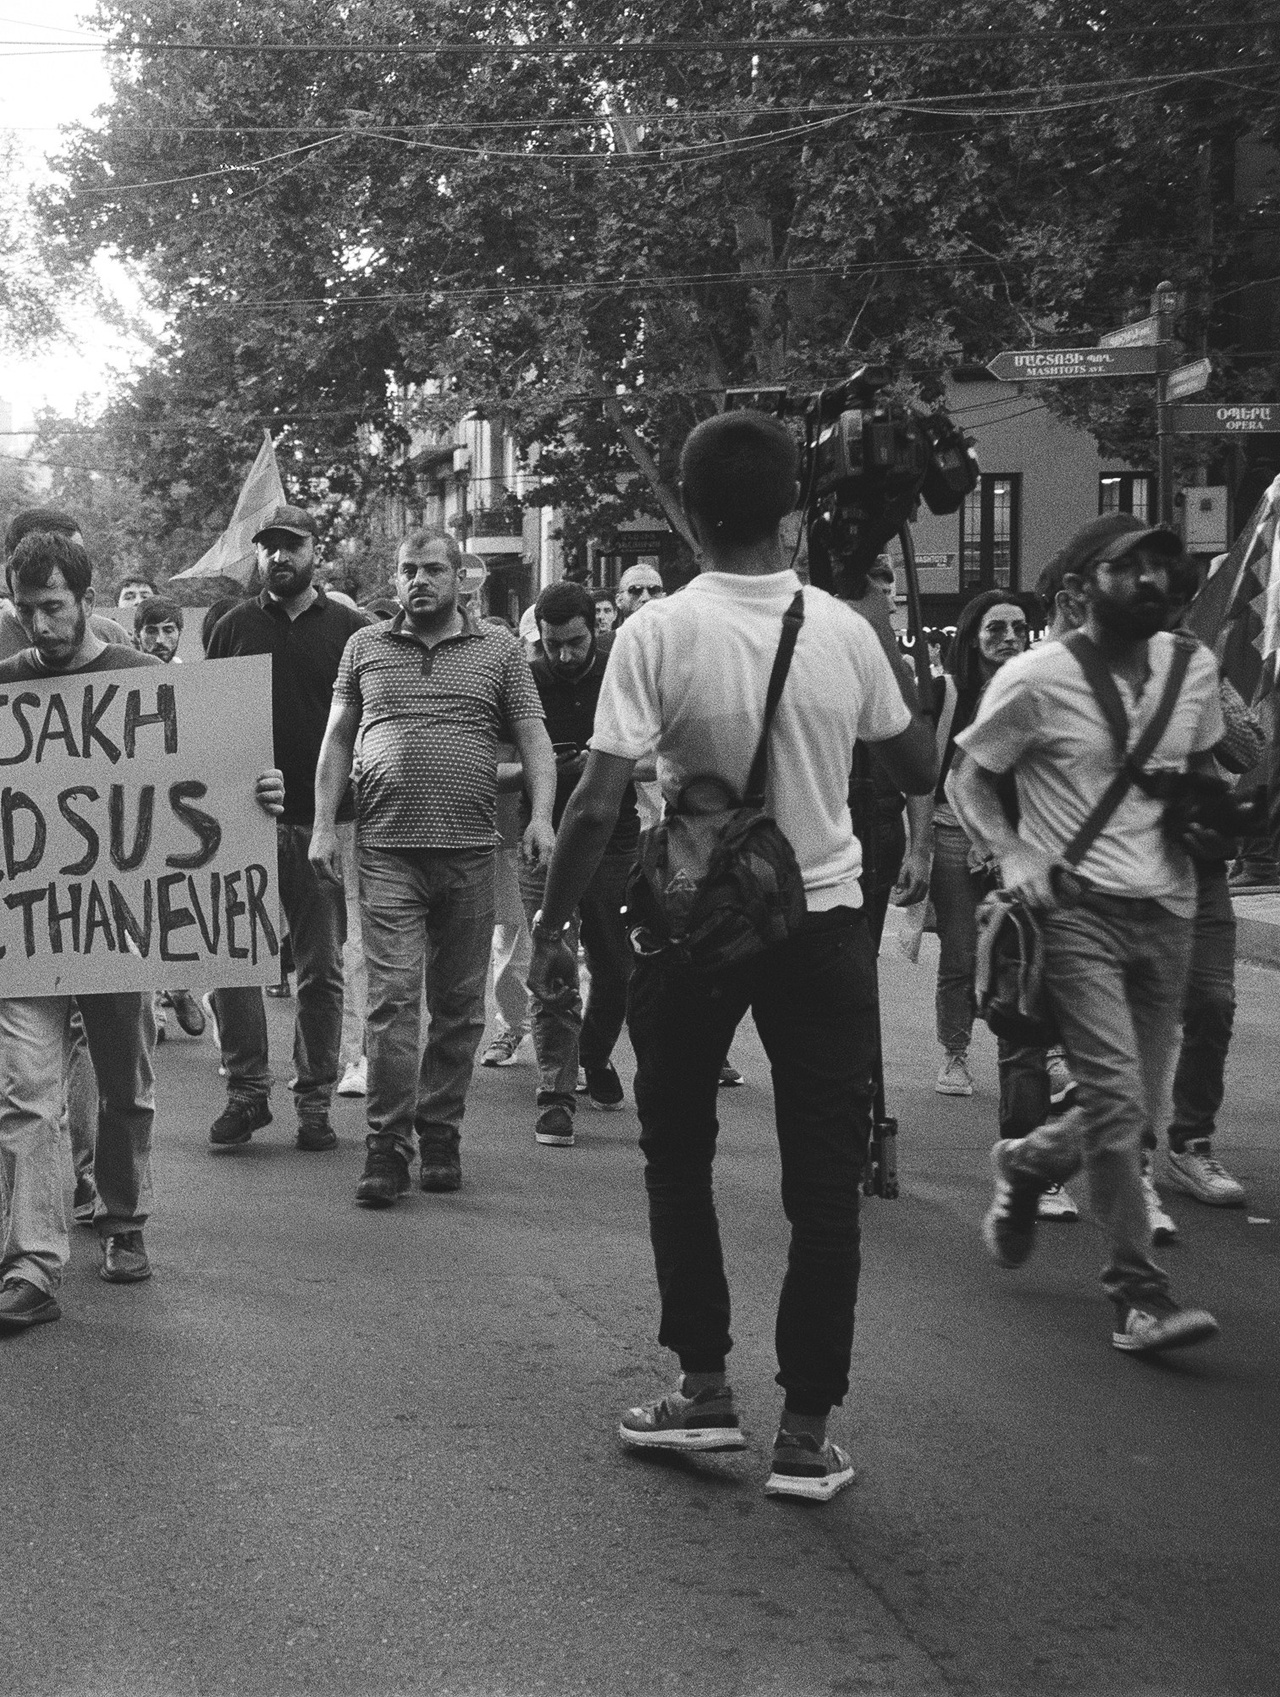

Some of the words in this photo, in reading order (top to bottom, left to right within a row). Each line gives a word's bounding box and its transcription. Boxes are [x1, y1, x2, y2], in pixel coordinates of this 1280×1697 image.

[1014, 352, 1084, 367] ՄԱՇՏՈՑԻ
[1025, 364, 1087, 376] MASHTOTS
[1216, 406, 1272, 421] ՕՊԵՐԱ
[1225, 420, 1265, 430] OPERA
